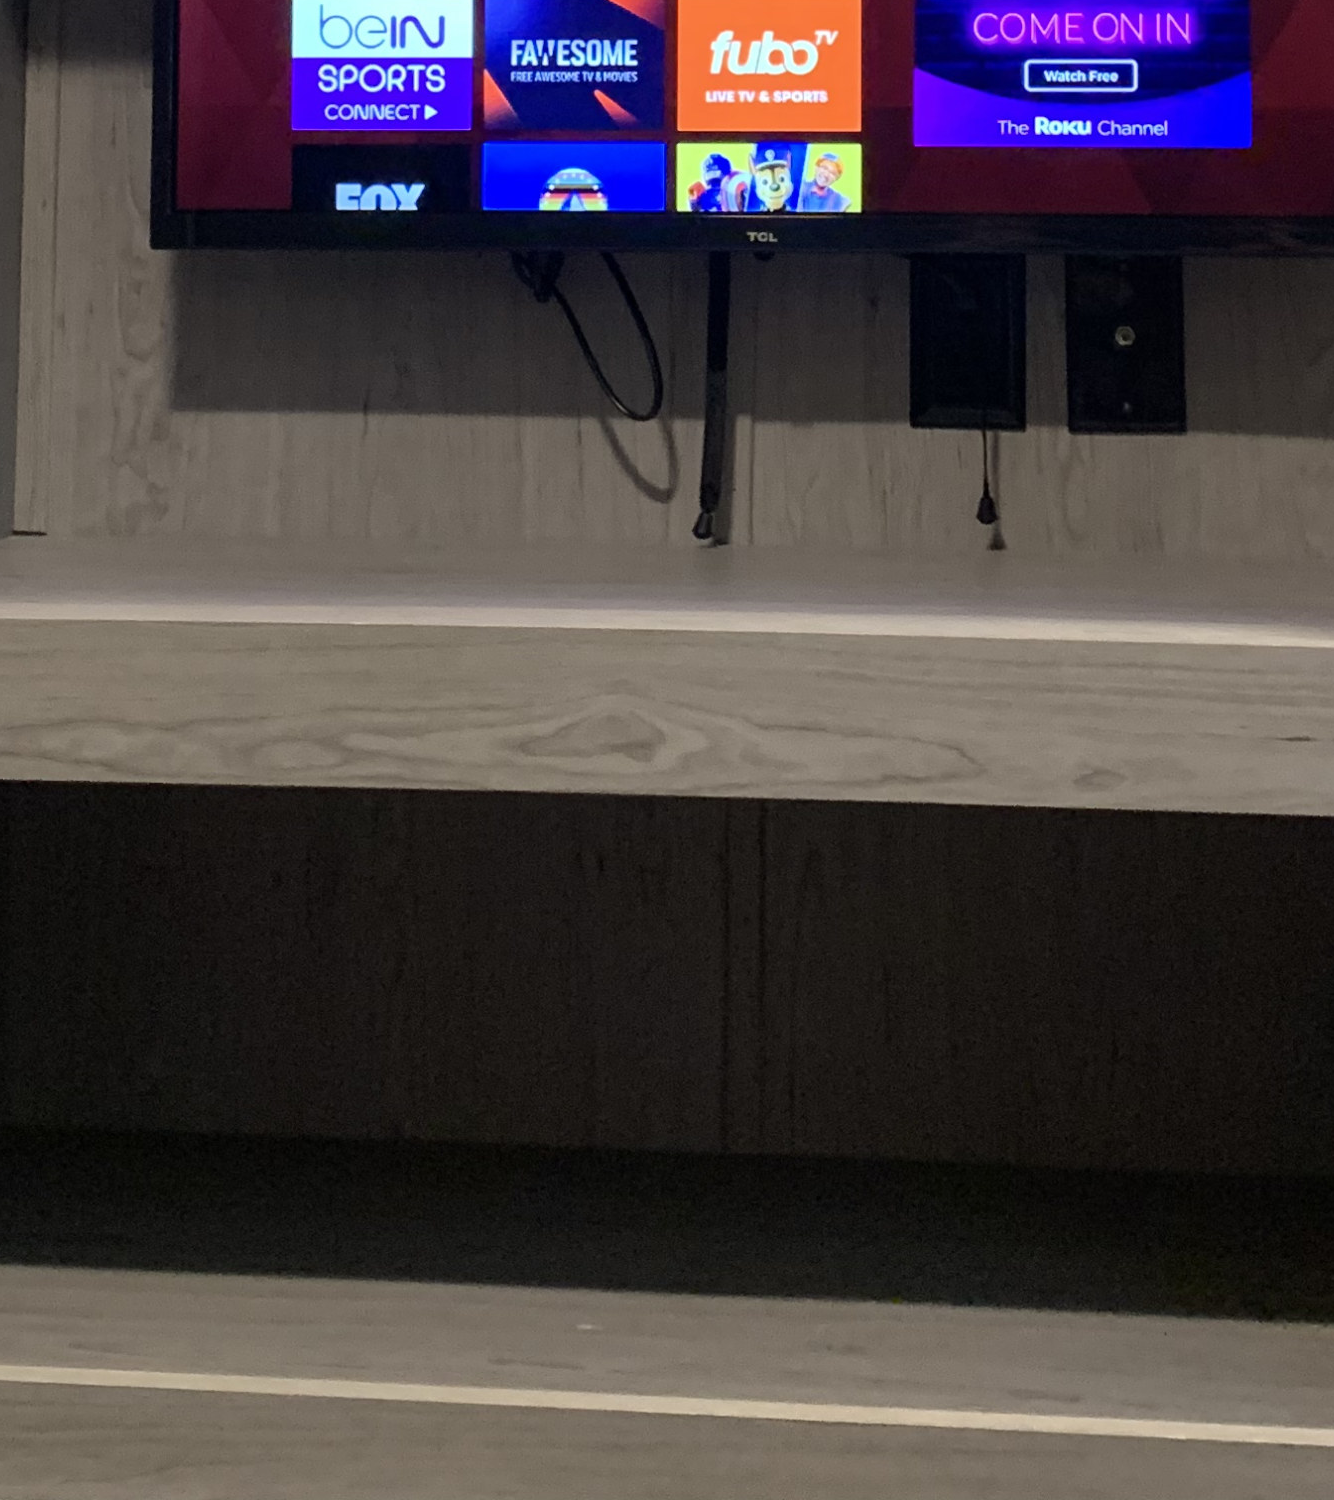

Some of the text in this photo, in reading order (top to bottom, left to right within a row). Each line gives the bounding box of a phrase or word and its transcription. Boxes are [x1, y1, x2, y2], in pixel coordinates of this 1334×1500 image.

[319, 4, 445, 49] beIN
[973, 12, 1191, 43] COME ON IN
[510, 39, 638, 66] FAWESOME
[710, 30, 839, 75] fubo TV
[318, 63, 445, 93] SPORTS
[510, 71, 638, 82] FREE AWESOME TV & MOVIES
[1044, 69, 1119, 84] Watch Free
[705, 90, 828, 103] LIVE TV & SPORTS
[324, 103, 420, 121] CONNECT
[998, 116, 1168, 136] The Roku Channel
[747, 231, 778, 243] TCL
